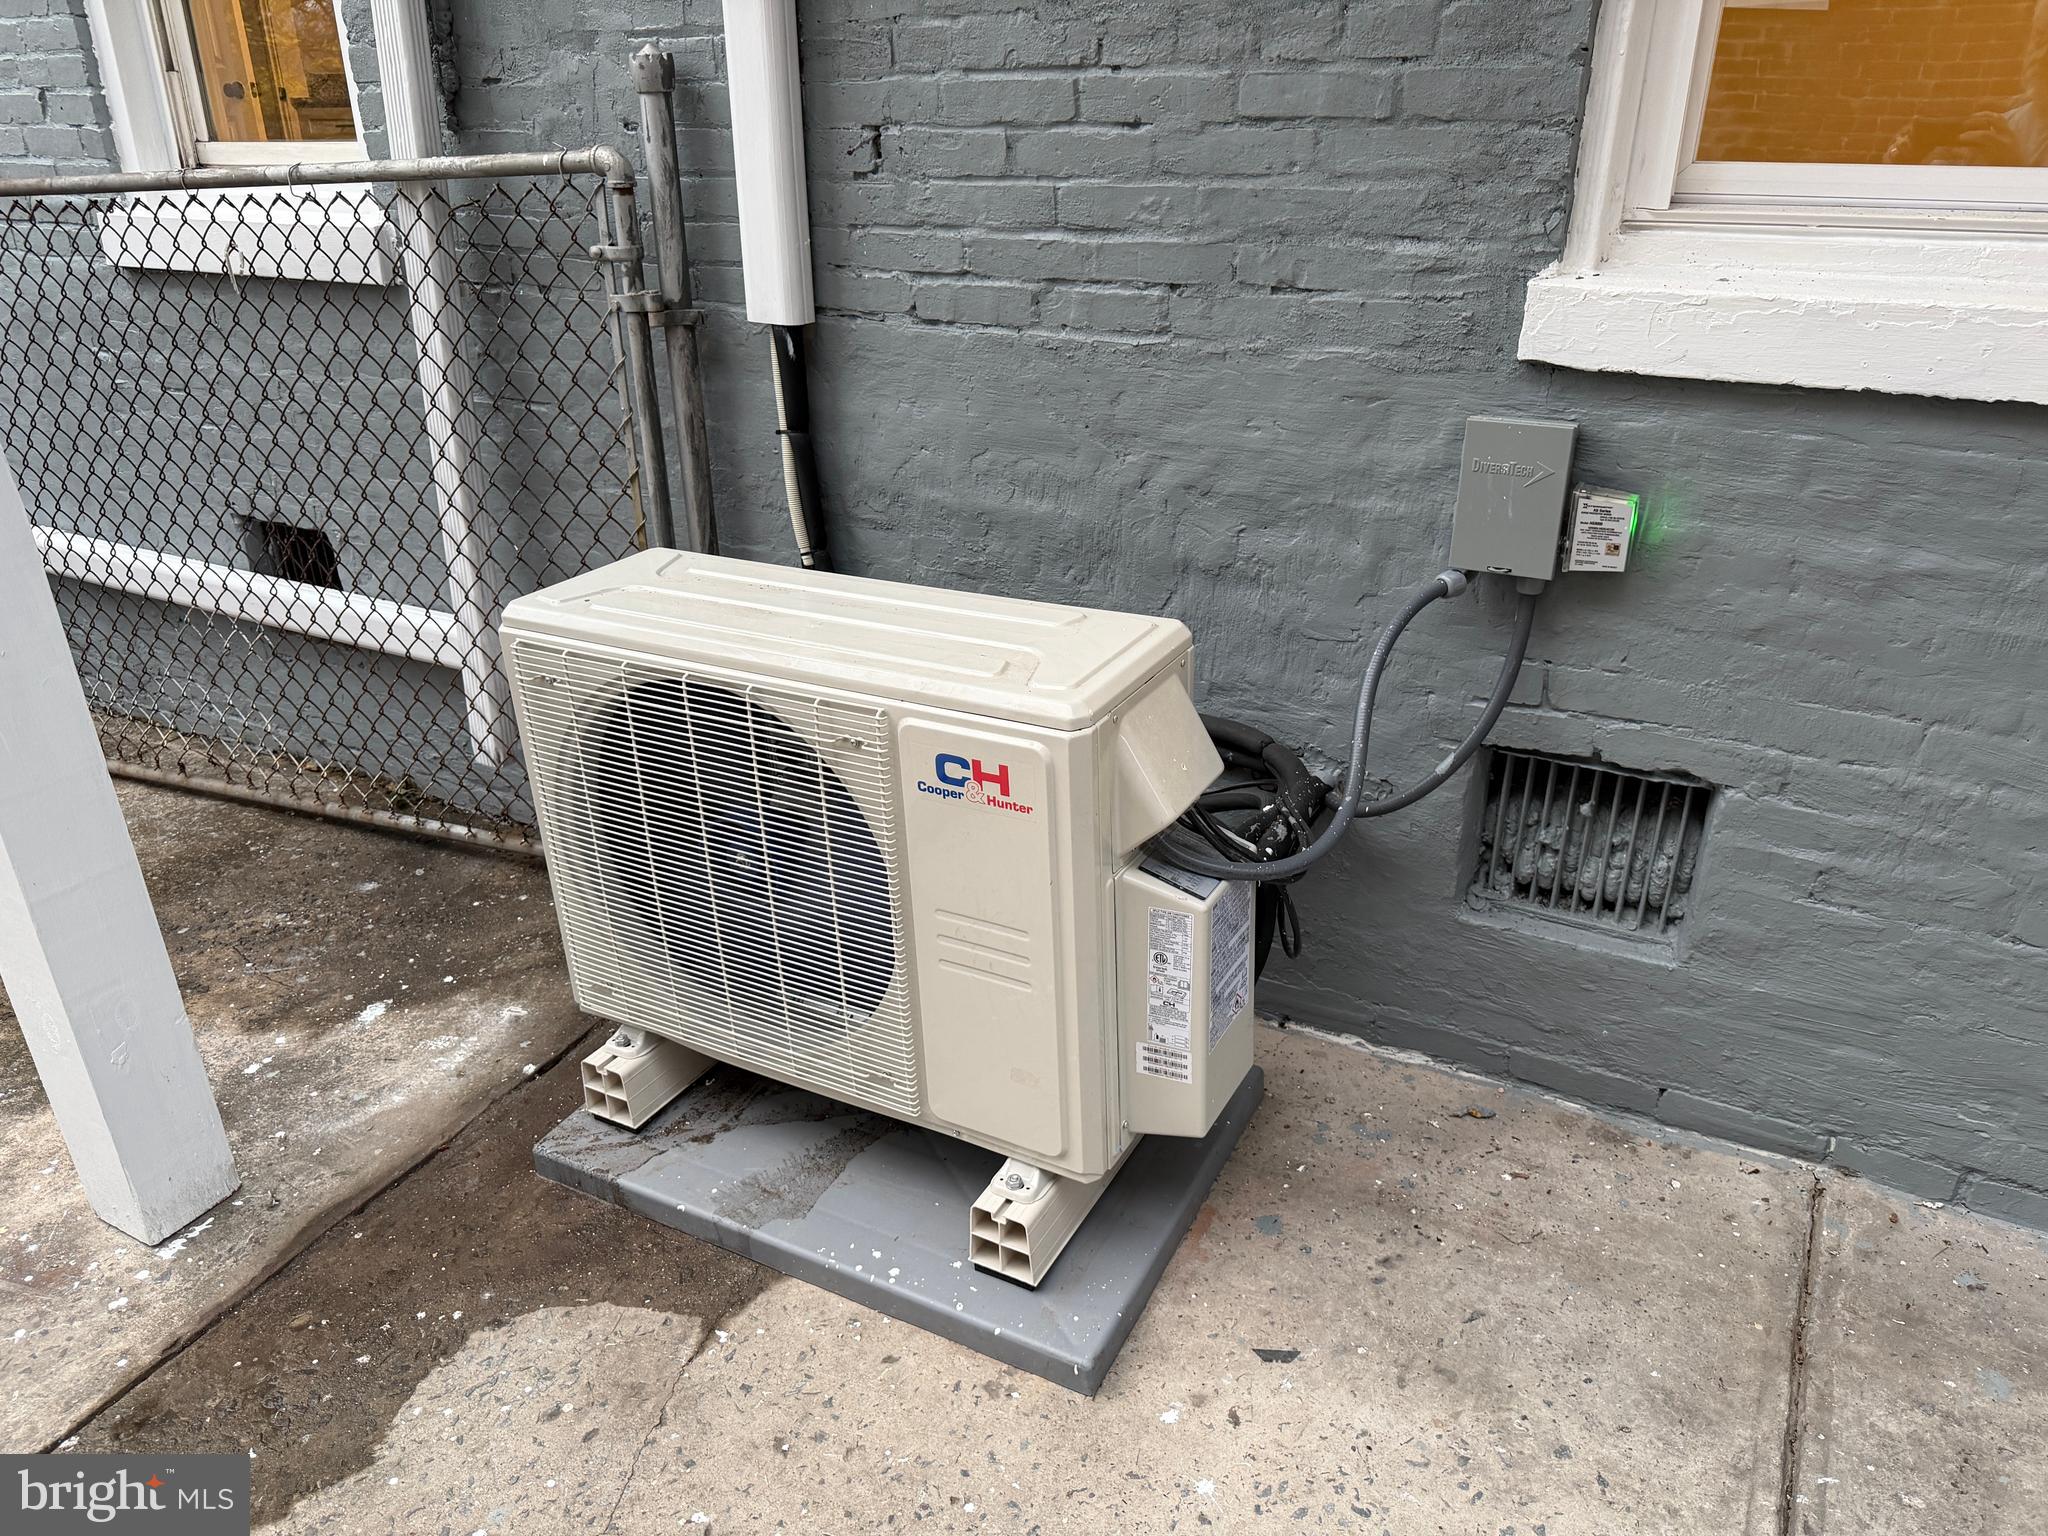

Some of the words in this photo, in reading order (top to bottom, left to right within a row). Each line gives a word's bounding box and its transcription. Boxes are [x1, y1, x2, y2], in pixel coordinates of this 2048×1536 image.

[917, 781, 964, 799] Cooper
[965, 781, 986, 804] &
[986, 795, 1034, 815] Hunter
